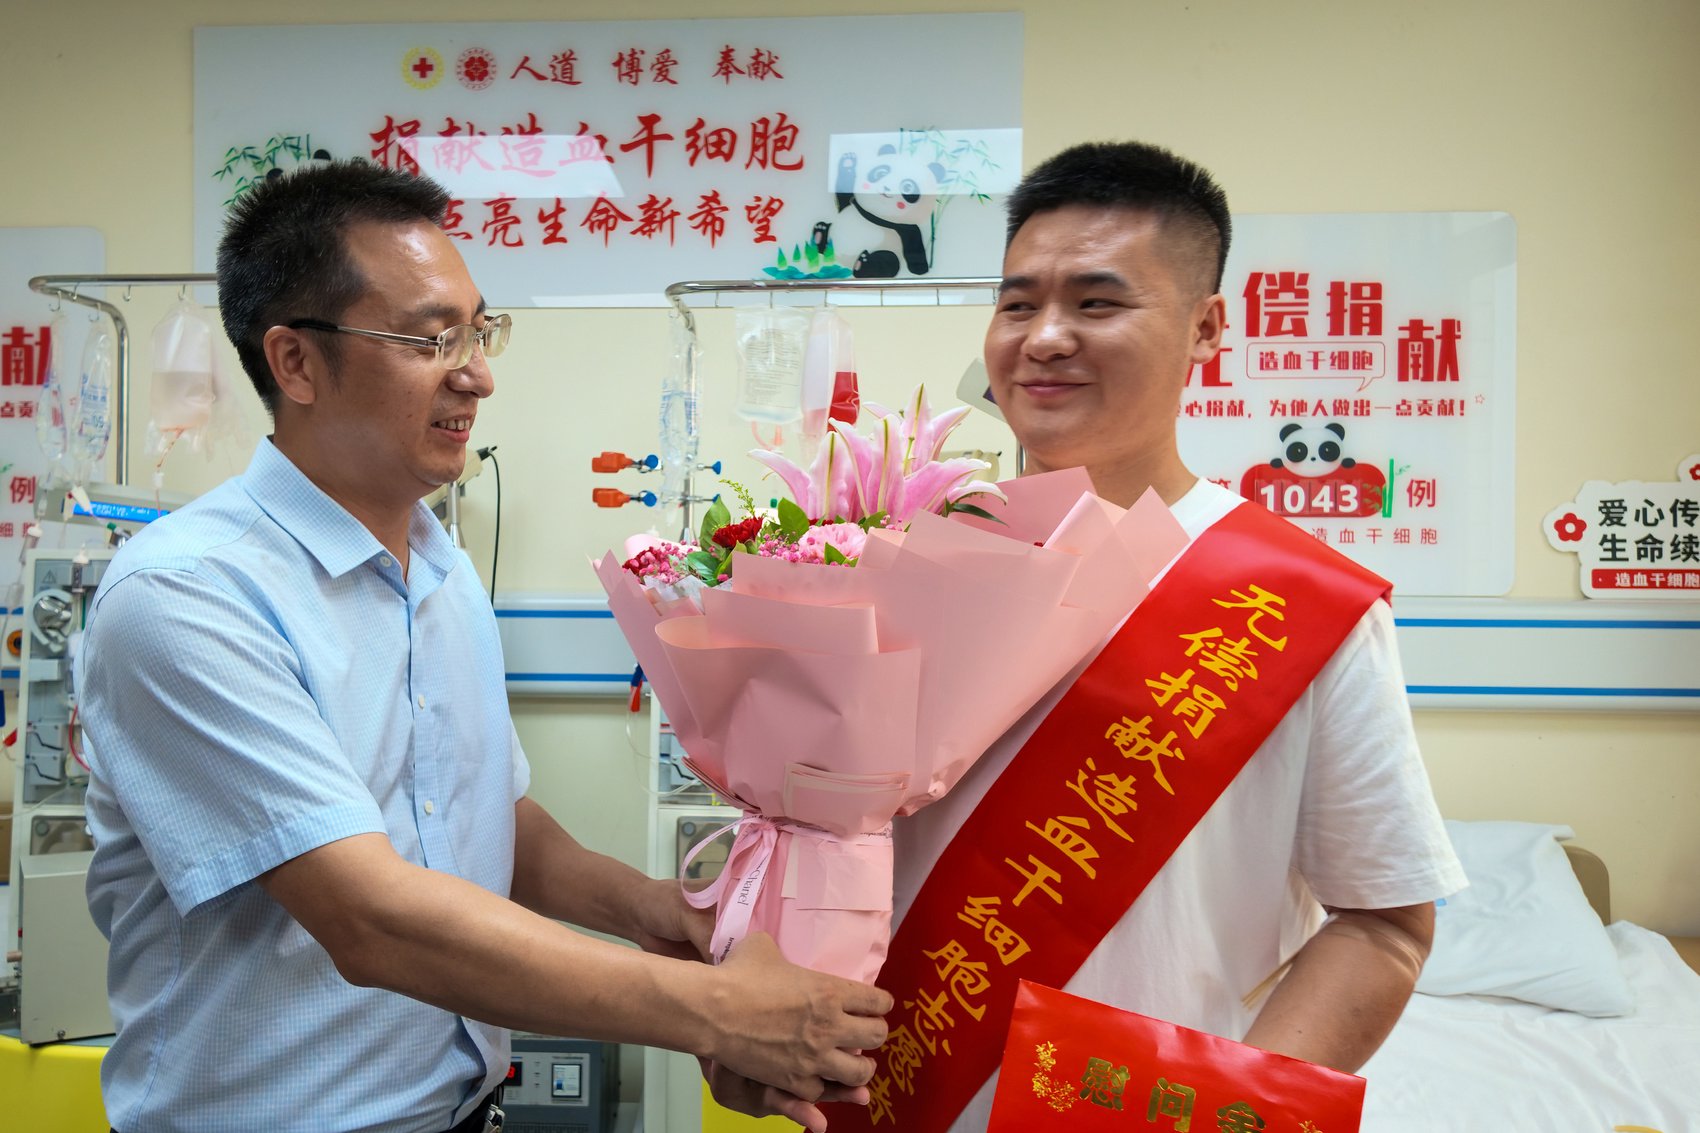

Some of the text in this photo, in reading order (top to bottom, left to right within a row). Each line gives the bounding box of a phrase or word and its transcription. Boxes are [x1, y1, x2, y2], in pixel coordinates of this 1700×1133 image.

[510, 49, 583, 86] 人道
[612, 48, 679, 86] 博爱
[712, 45, 784, 86] 奉献
[369, 112, 804, 179] 捐献造血干细胞
[441, 189, 784, 249] 点亮生命新希望
[1259, 351, 1374, 371] 造血干细胞
[10, 475, 37, 504] 例
[1260, 479, 1437, 513] 1043 例
[1598, 498, 1700, 528] 爱心传
[1599, 533, 1700, 563] 生命续
[1615, 572, 1700, 588] 造血干细胞
